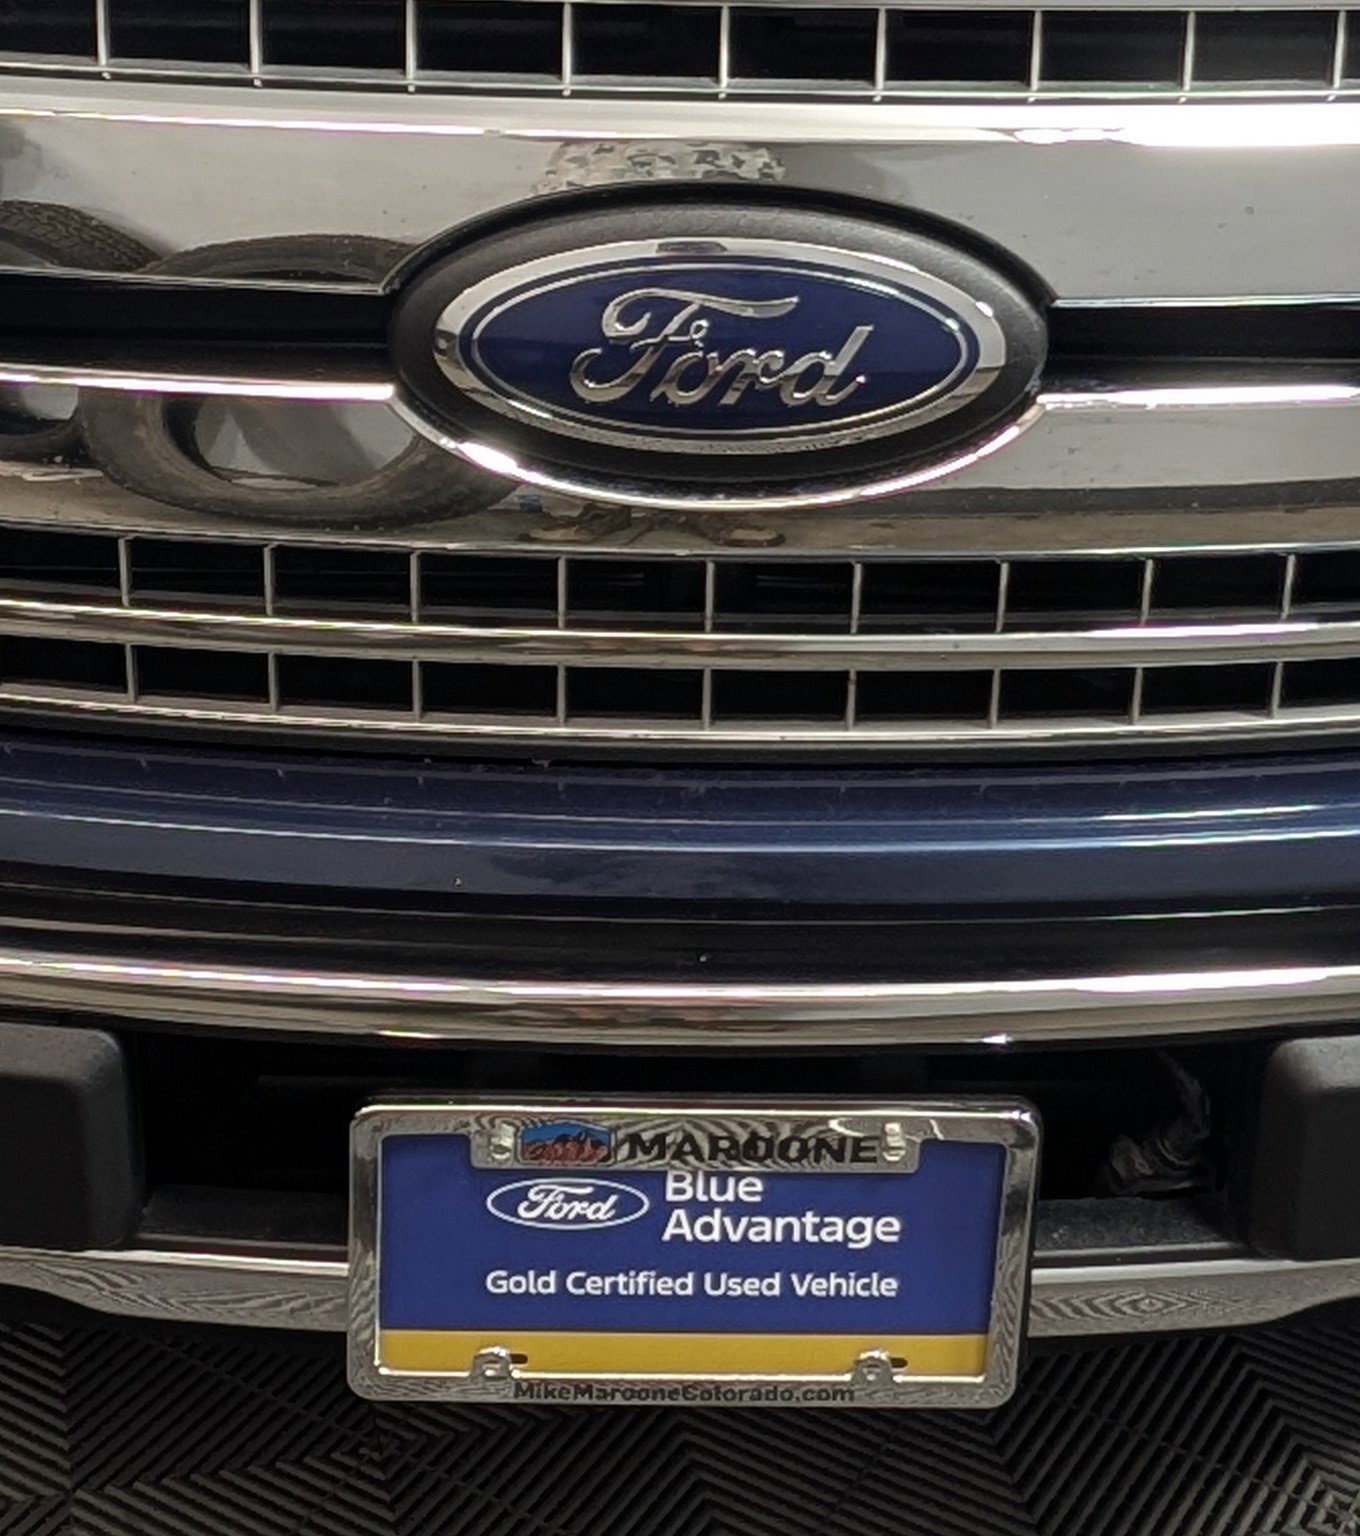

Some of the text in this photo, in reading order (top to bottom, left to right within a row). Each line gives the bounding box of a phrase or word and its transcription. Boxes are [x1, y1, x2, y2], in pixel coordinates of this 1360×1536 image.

[569, 287, 874, 407] Ford
[626, 1133, 879, 1164] MAROONE
[516, 1181, 617, 1222] Ford
[665, 1170, 764, 1202] Blue
[661, 1208, 902, 1249] Advantage
[486, 1270, 899, 1298] Gold Certified Used Vehicle
[513, 1382, 856, 1402] MikeMarooneColorado.com
